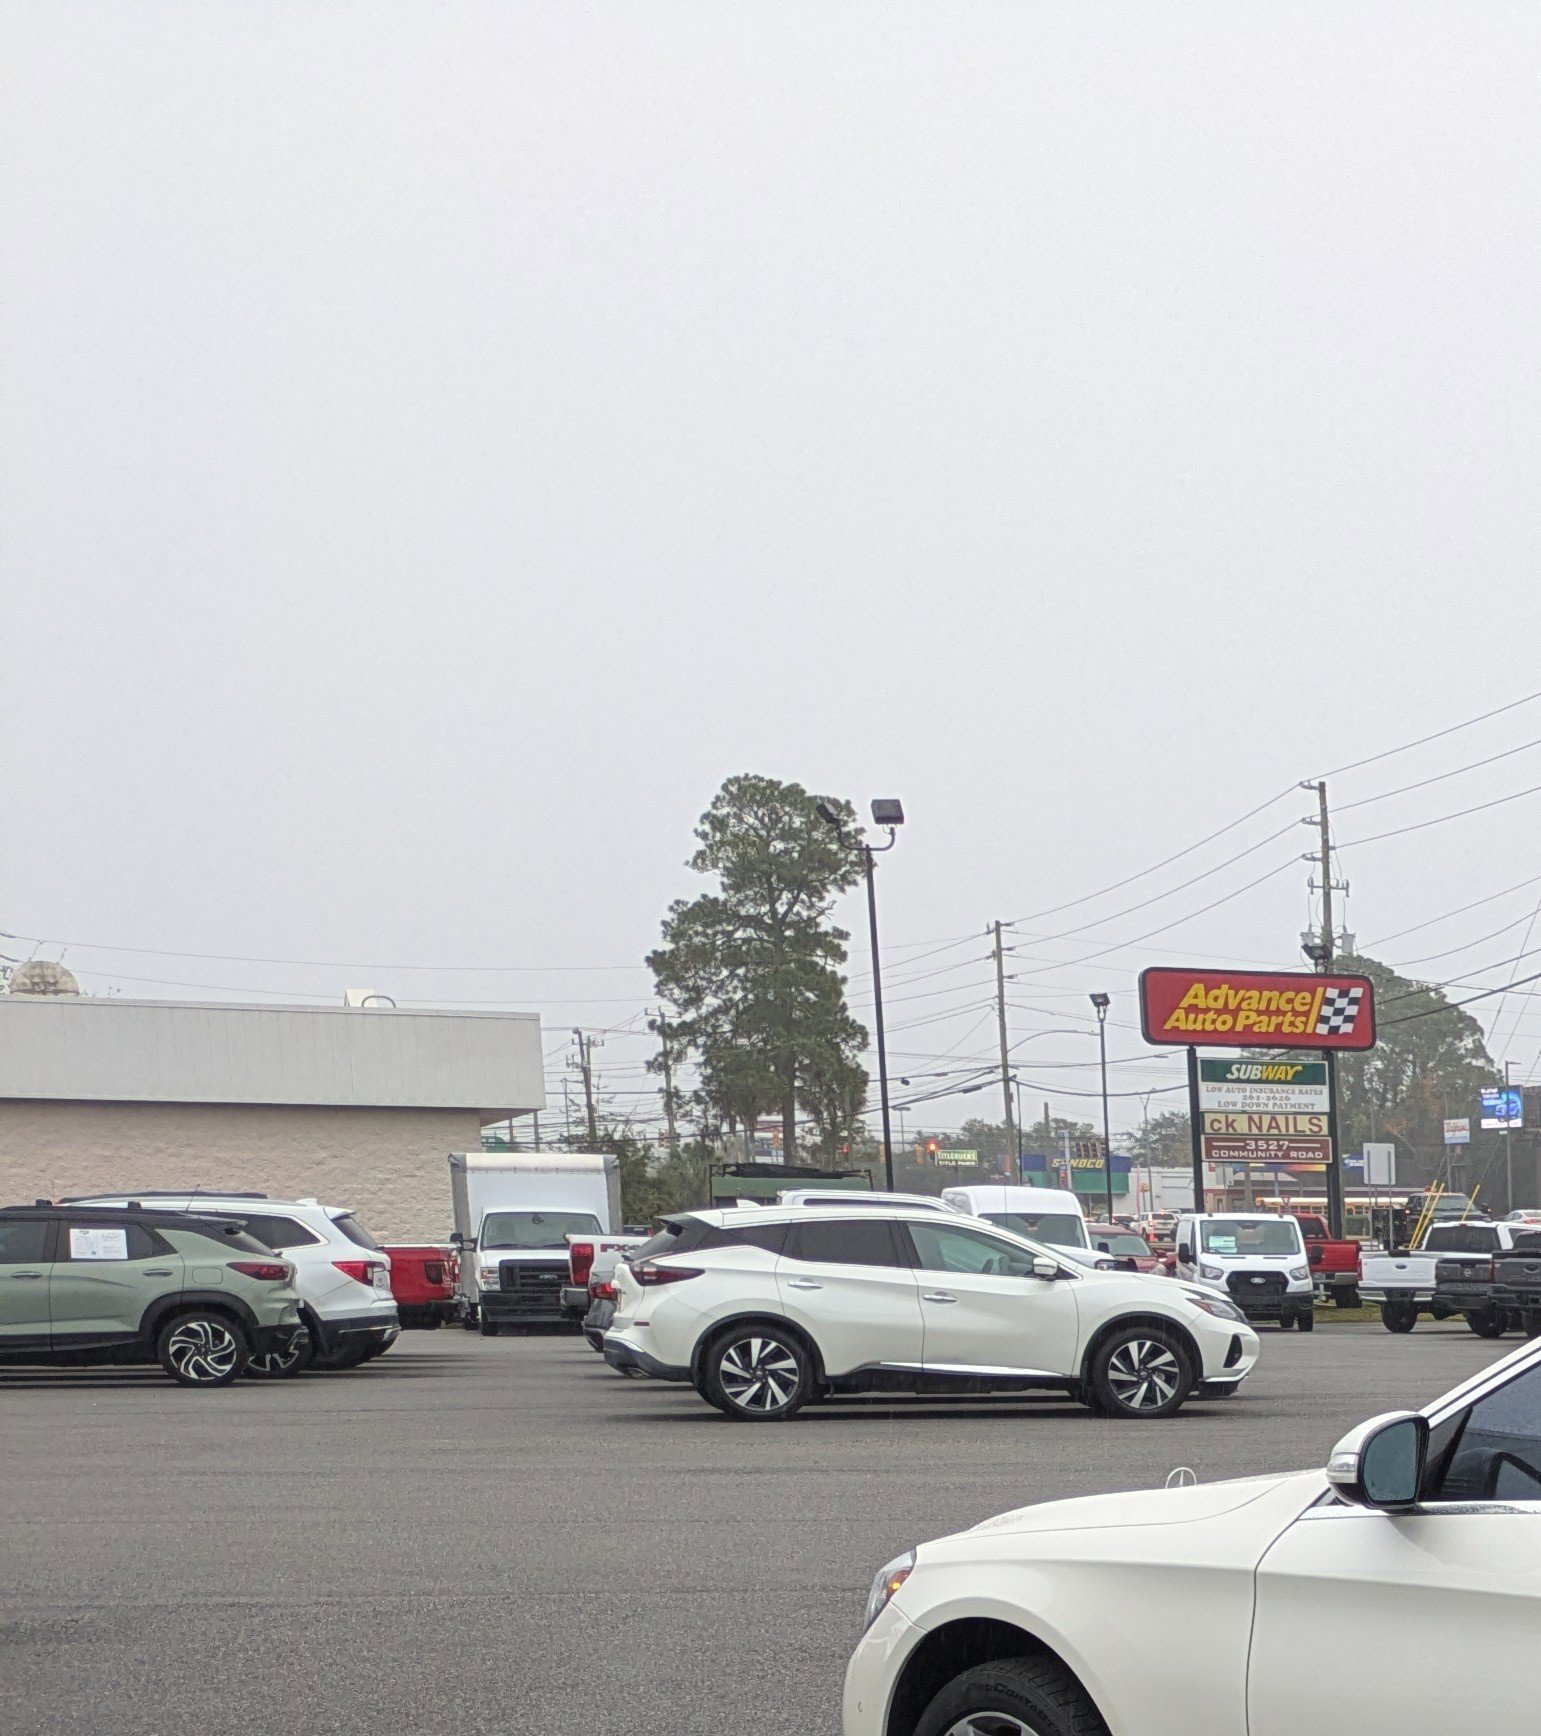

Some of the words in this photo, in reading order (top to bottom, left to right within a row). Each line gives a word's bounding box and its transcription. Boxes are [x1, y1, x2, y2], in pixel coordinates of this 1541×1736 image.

[1179, 983, 1312, 1012] Advance
[1163, 1008, 1234, 1032] Auto
[1235, 1010, 1307, 1033] Parts
[1226, 1063, 1303, 1081] SUBWAY
[1225, 1086, 1248, 1094] AUTO
[1249, 1087, 1296, 1095] INSURANCE
[1297, 1088, 1324, 1096] RATES
[1216, 1100, 1239, 1108] LOW
[1240, 1101, 1270, 1109] DOWN
[1271, 1102, 1316, 1110] PAYMENT
[1248, 1115, 1323, 1134] NAILS
[1245, 1140, 1290, 1150] 3527
[1212, 1149, 1283, 1158] COMMUNITY
[1290, 1151, 1323, 1159] ROAD
